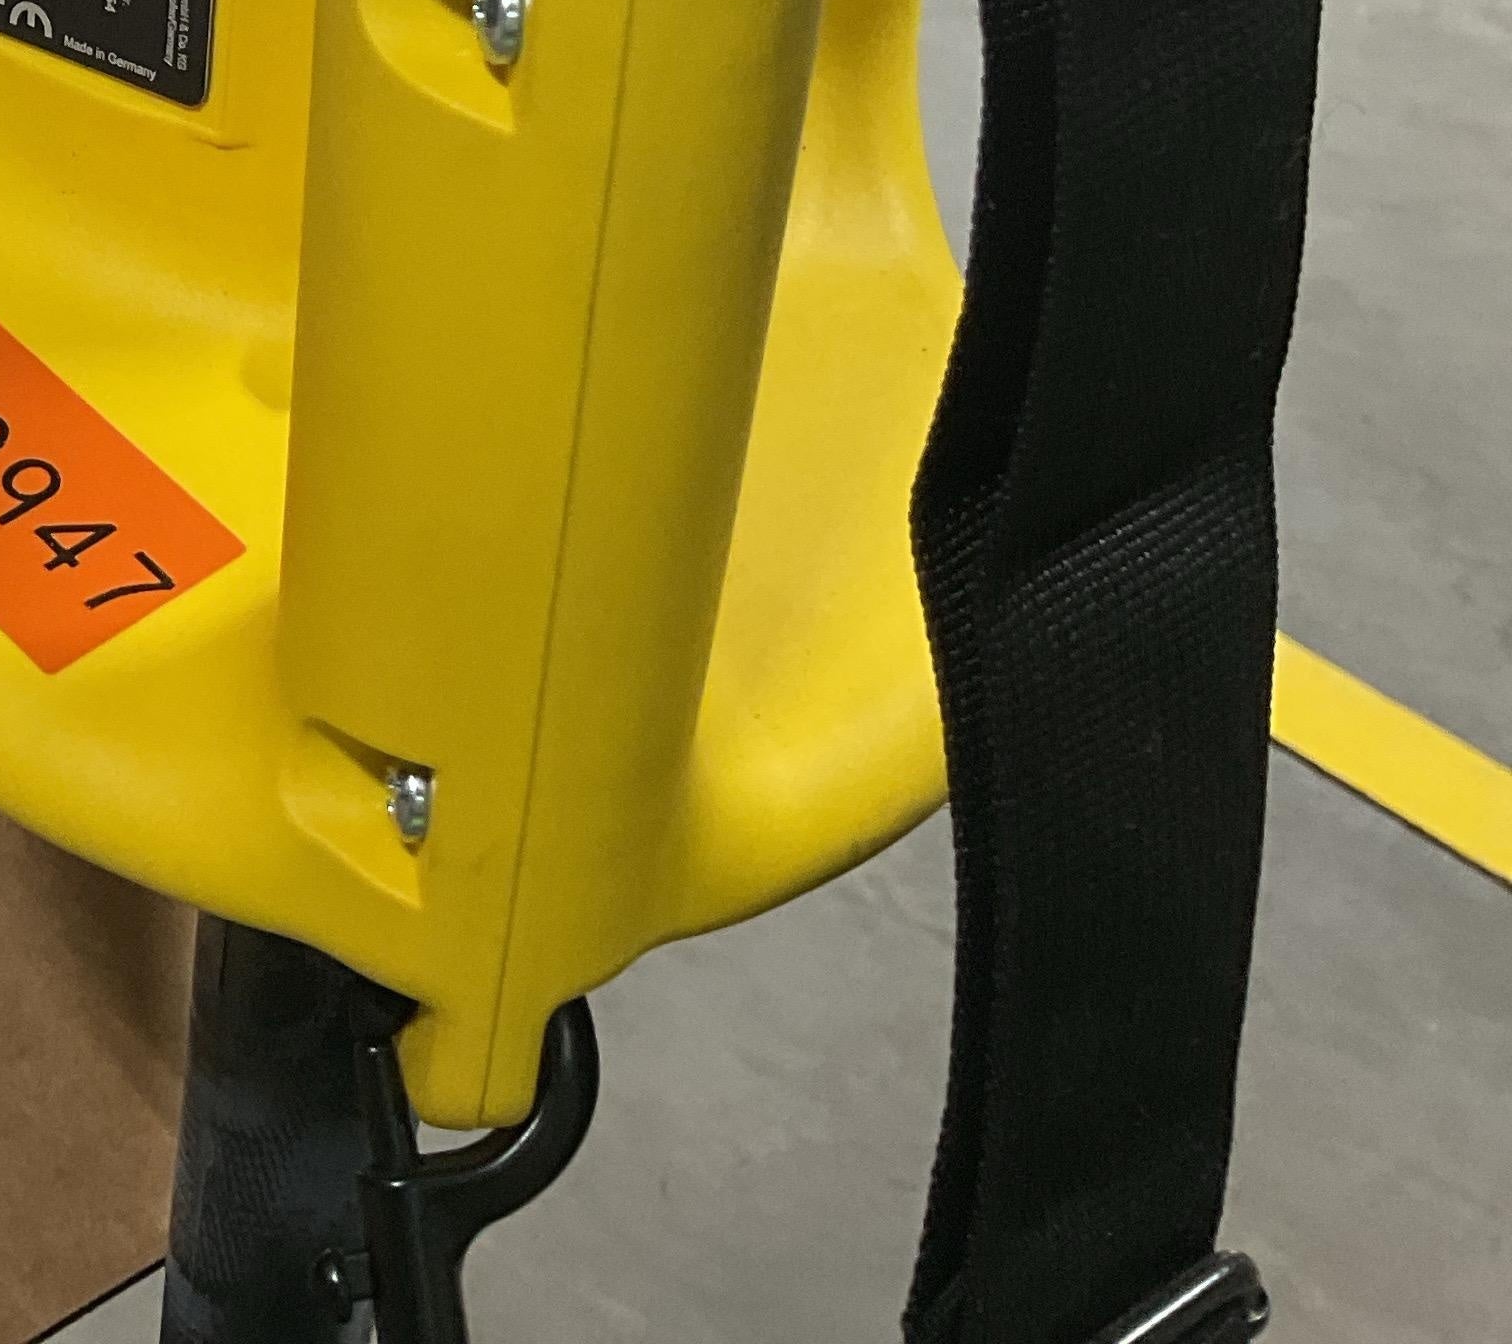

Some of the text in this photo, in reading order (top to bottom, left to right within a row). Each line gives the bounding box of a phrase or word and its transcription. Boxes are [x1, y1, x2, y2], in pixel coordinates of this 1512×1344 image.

[63, 34, 157, 82] Made in Germany
